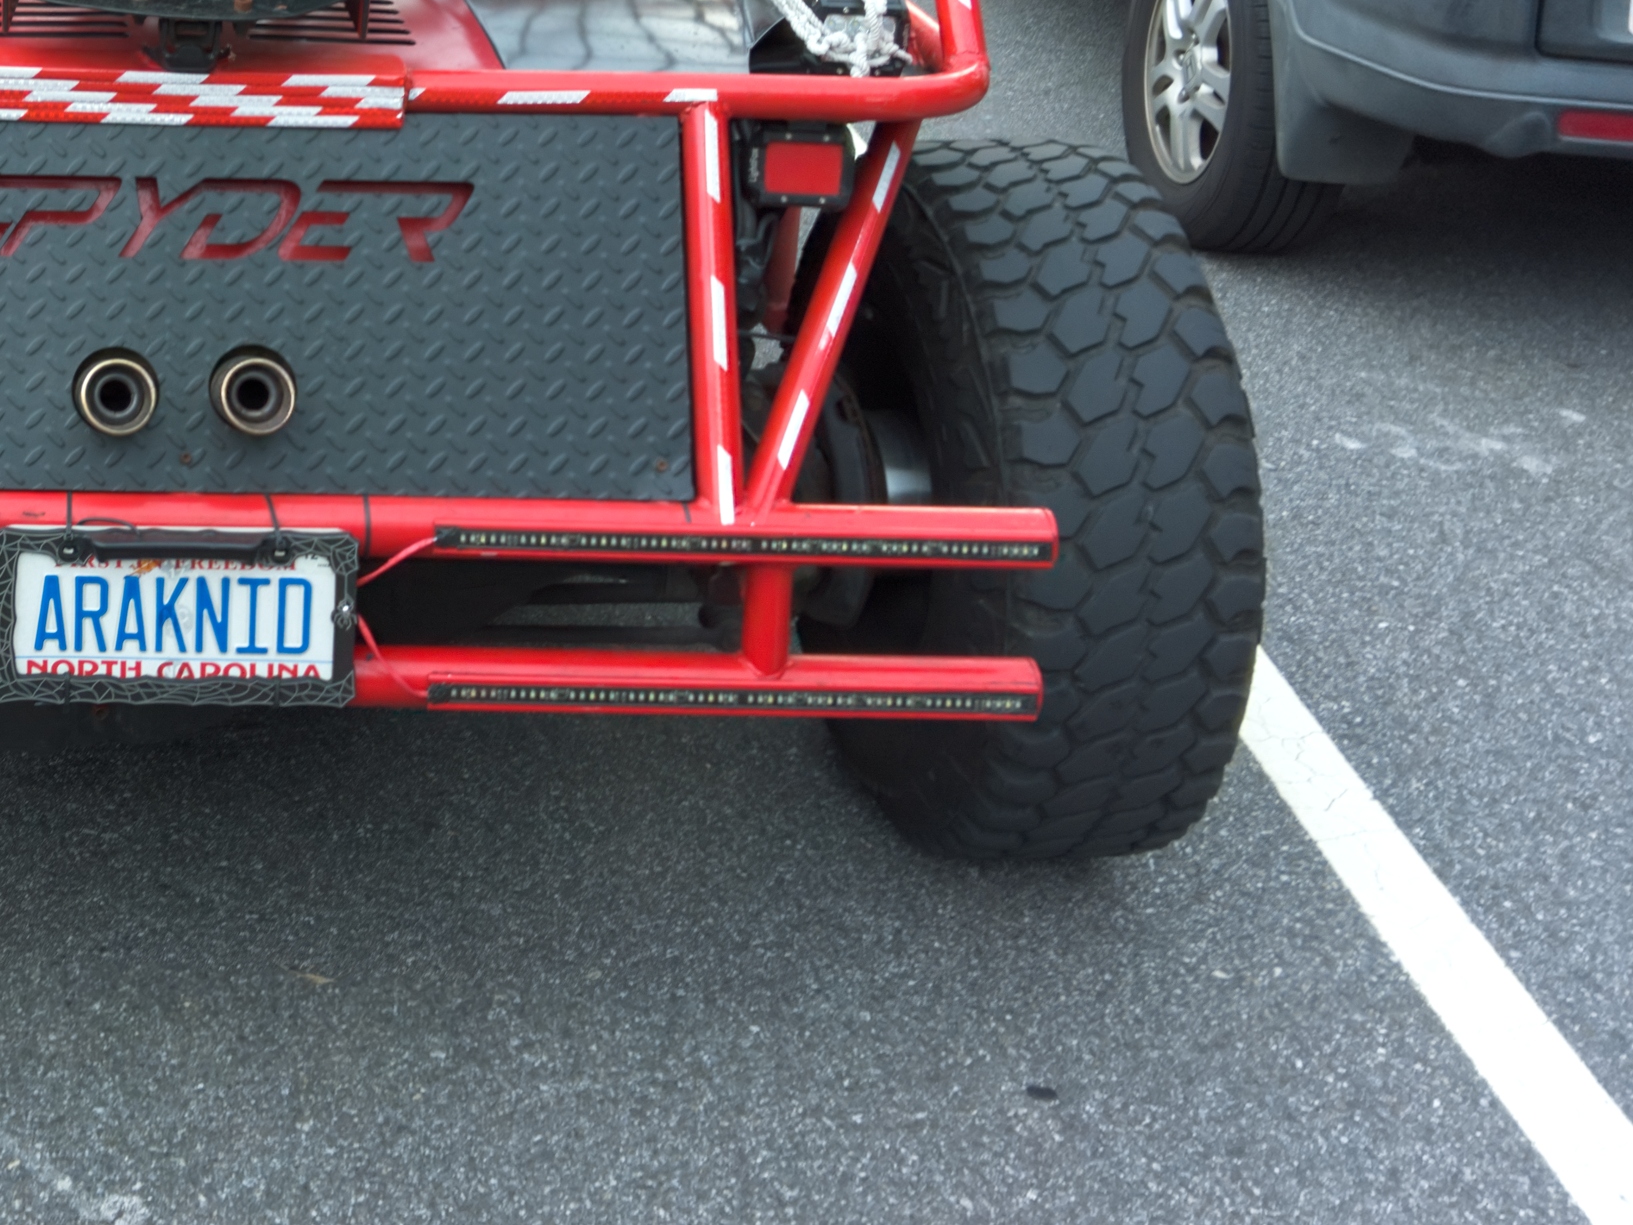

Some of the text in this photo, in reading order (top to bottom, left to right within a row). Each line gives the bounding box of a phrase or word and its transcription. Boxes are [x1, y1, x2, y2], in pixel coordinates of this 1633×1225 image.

[34, 574, 312, 655] ARAKNID
[26, 659, 322, 680] NORTH CAROLINA
